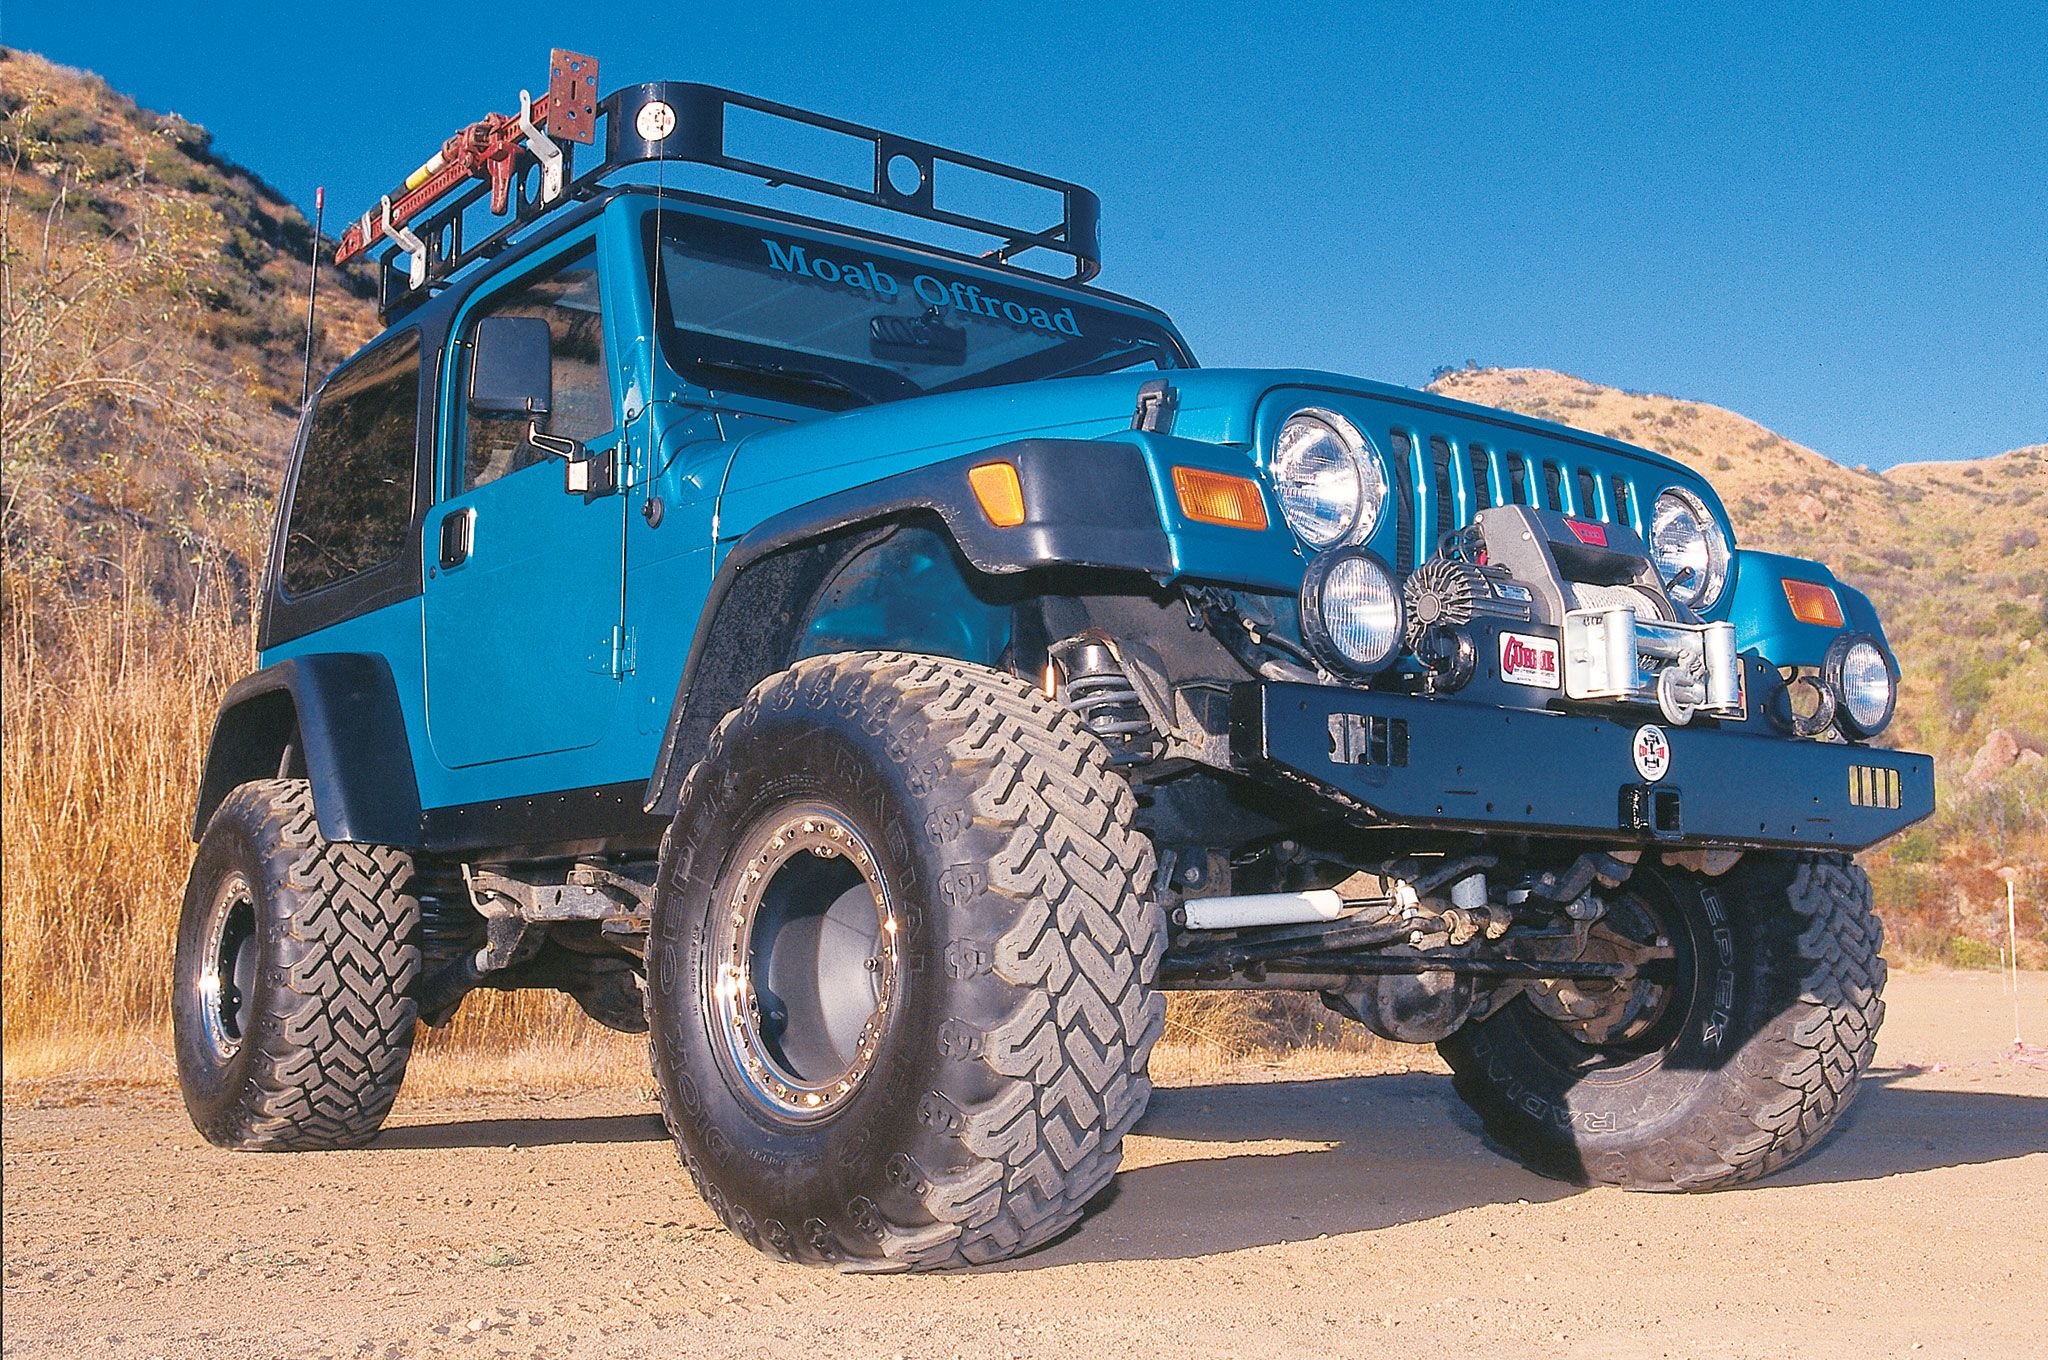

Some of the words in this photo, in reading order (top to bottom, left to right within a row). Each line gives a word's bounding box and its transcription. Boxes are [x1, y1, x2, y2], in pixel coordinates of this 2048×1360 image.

[761, 238, 898, 296] Moab
[912, 274, 1084, 338] Offroad
[1696, 880, 1736, 1051] EPEK
[664, 1023, 736, 1168] DICK
[1472, 1030, 1617, 1134] RADIAL
